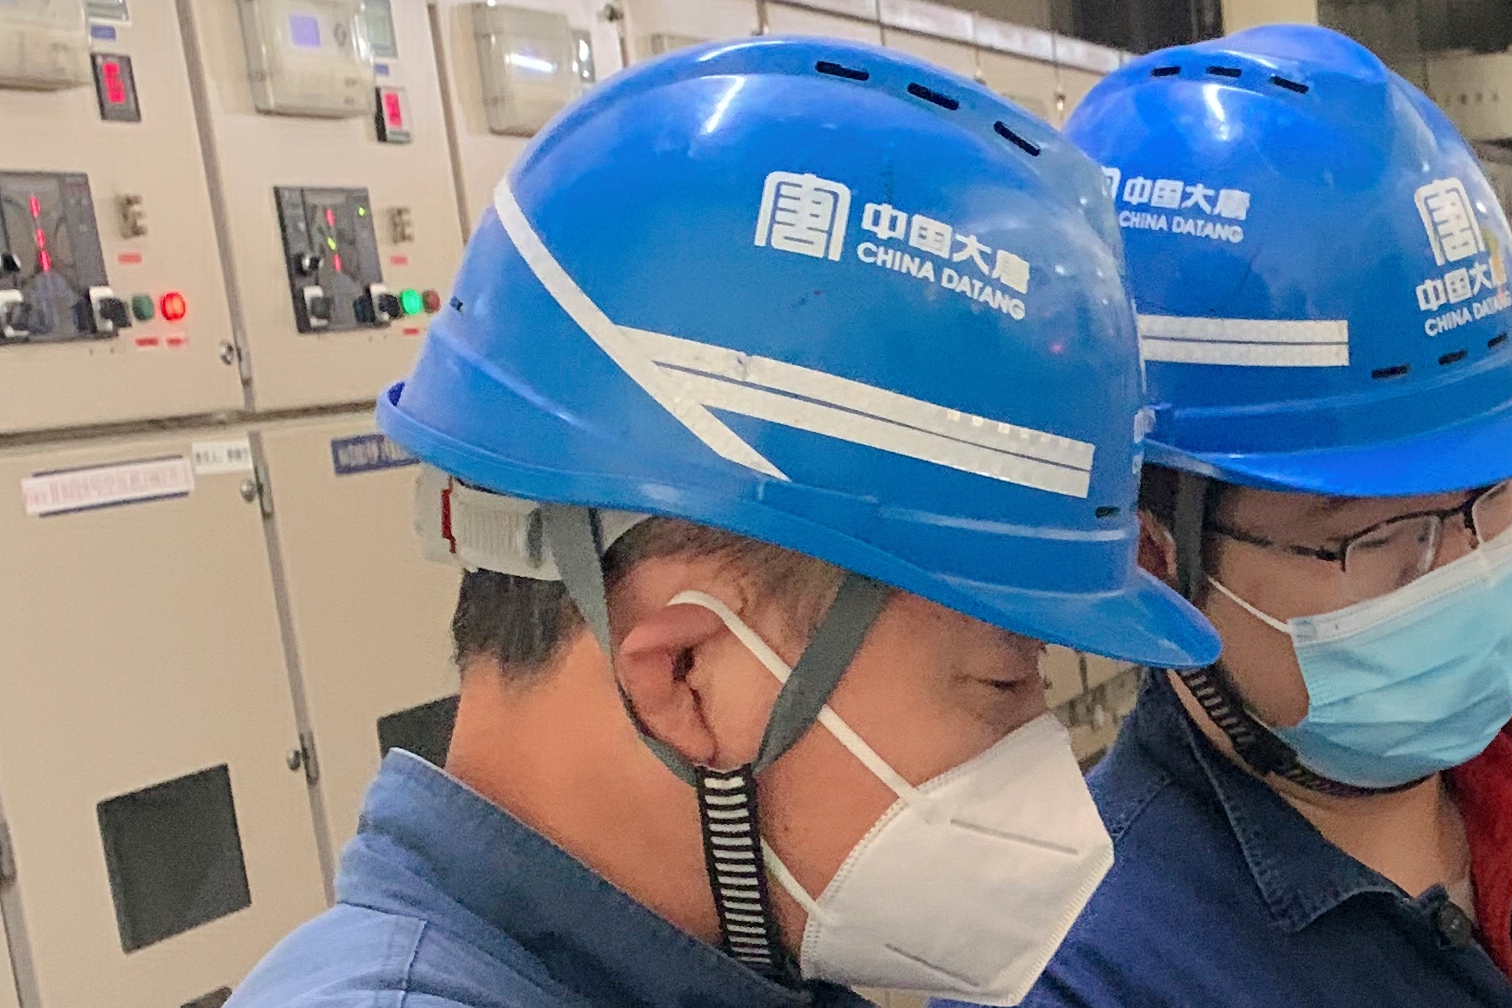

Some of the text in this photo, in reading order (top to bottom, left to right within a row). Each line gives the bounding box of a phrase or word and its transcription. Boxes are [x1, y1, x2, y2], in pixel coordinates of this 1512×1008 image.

[861, 202, 1031, 294] 中国大唐
[1119, 210, 1244, 243] CHINA DATANG
[857, 241, 1026, 320] CHINA DATANG
[1425, 307, 1472, 337] CHINA
